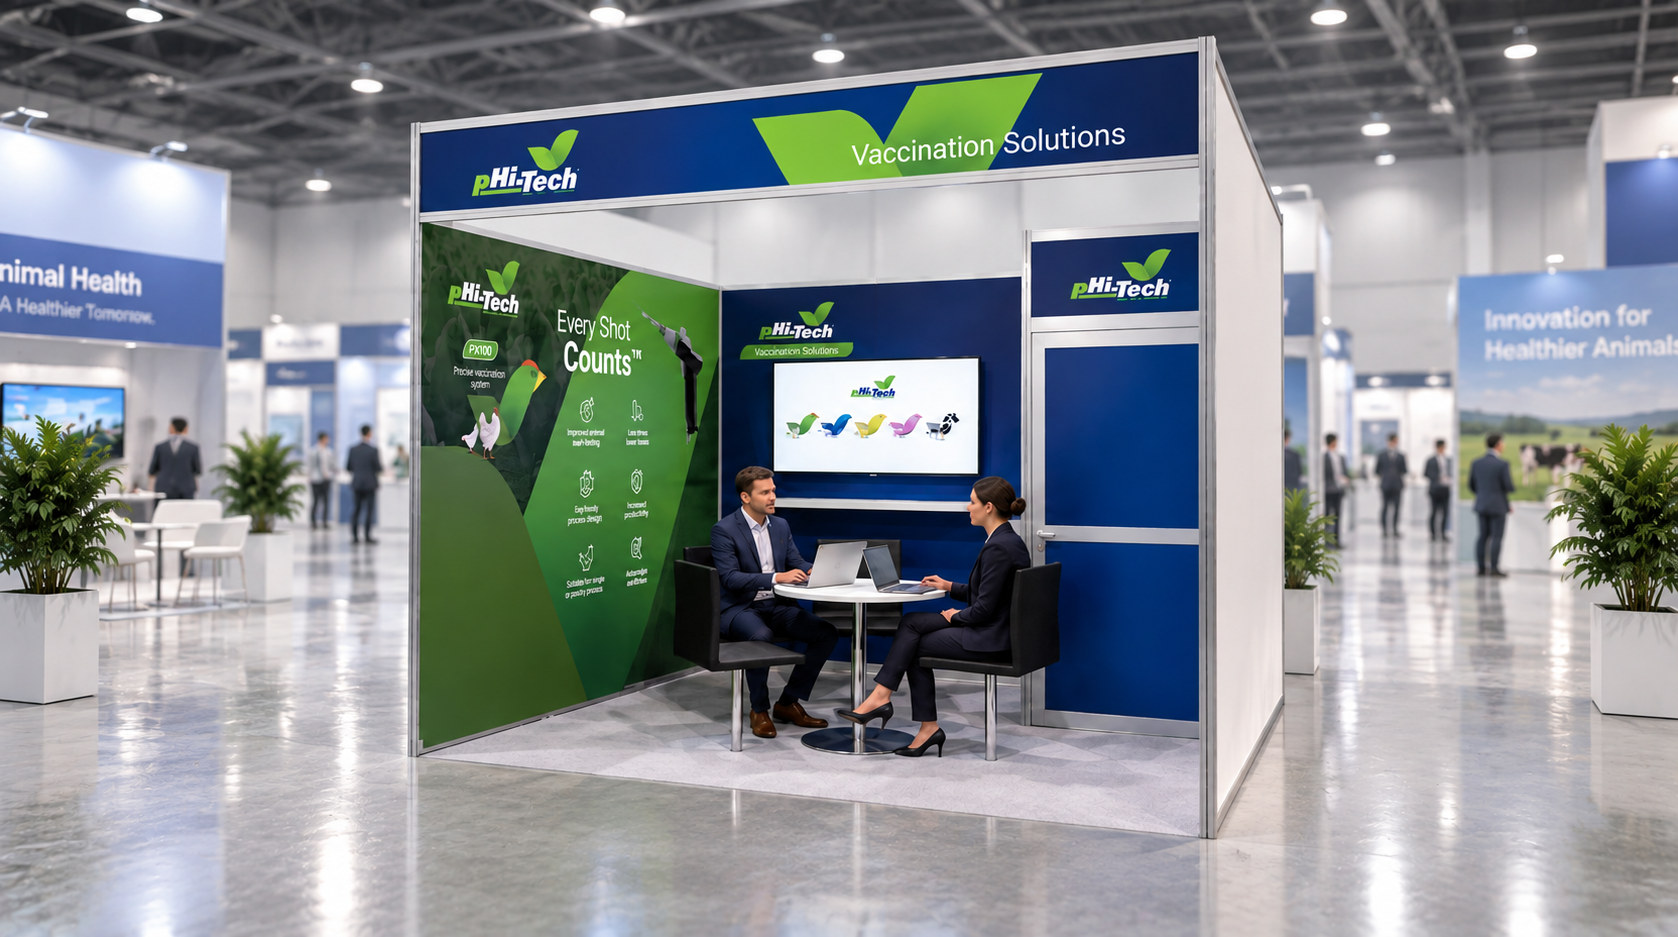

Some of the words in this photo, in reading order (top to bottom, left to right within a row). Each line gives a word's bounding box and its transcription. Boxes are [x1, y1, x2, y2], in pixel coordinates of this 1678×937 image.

[851, 133, 994, 167] Vaccination
[1003, 123, 1126, 155] Solutions
[472, 164, 578, 196] pHi-Tech
[71, 265, 142, 297] Health
[1070, 276, 1170, 300] pHi-Tech
[16, 297, 84, 319] Healthier
[447, 281, 519, 314] pHi-Tech
[557, 308, 596, 341] Every
[599, 315, 631, 341] Shot
[758, 322, 833, 340] pHi-Tech
[1484, 306, 1610, 332] Innovation
[1616, 304, 1652, 326] for
[469, 344, 492, 356] PX100
[754, 347, 800, 356] Vaccination
[802, 346, 839, 355] Solutions
[1484, 336, 1587, 362] Healthier
[1592, 333, 1678, 359] Animals
[470, 380, 490, 390] system
